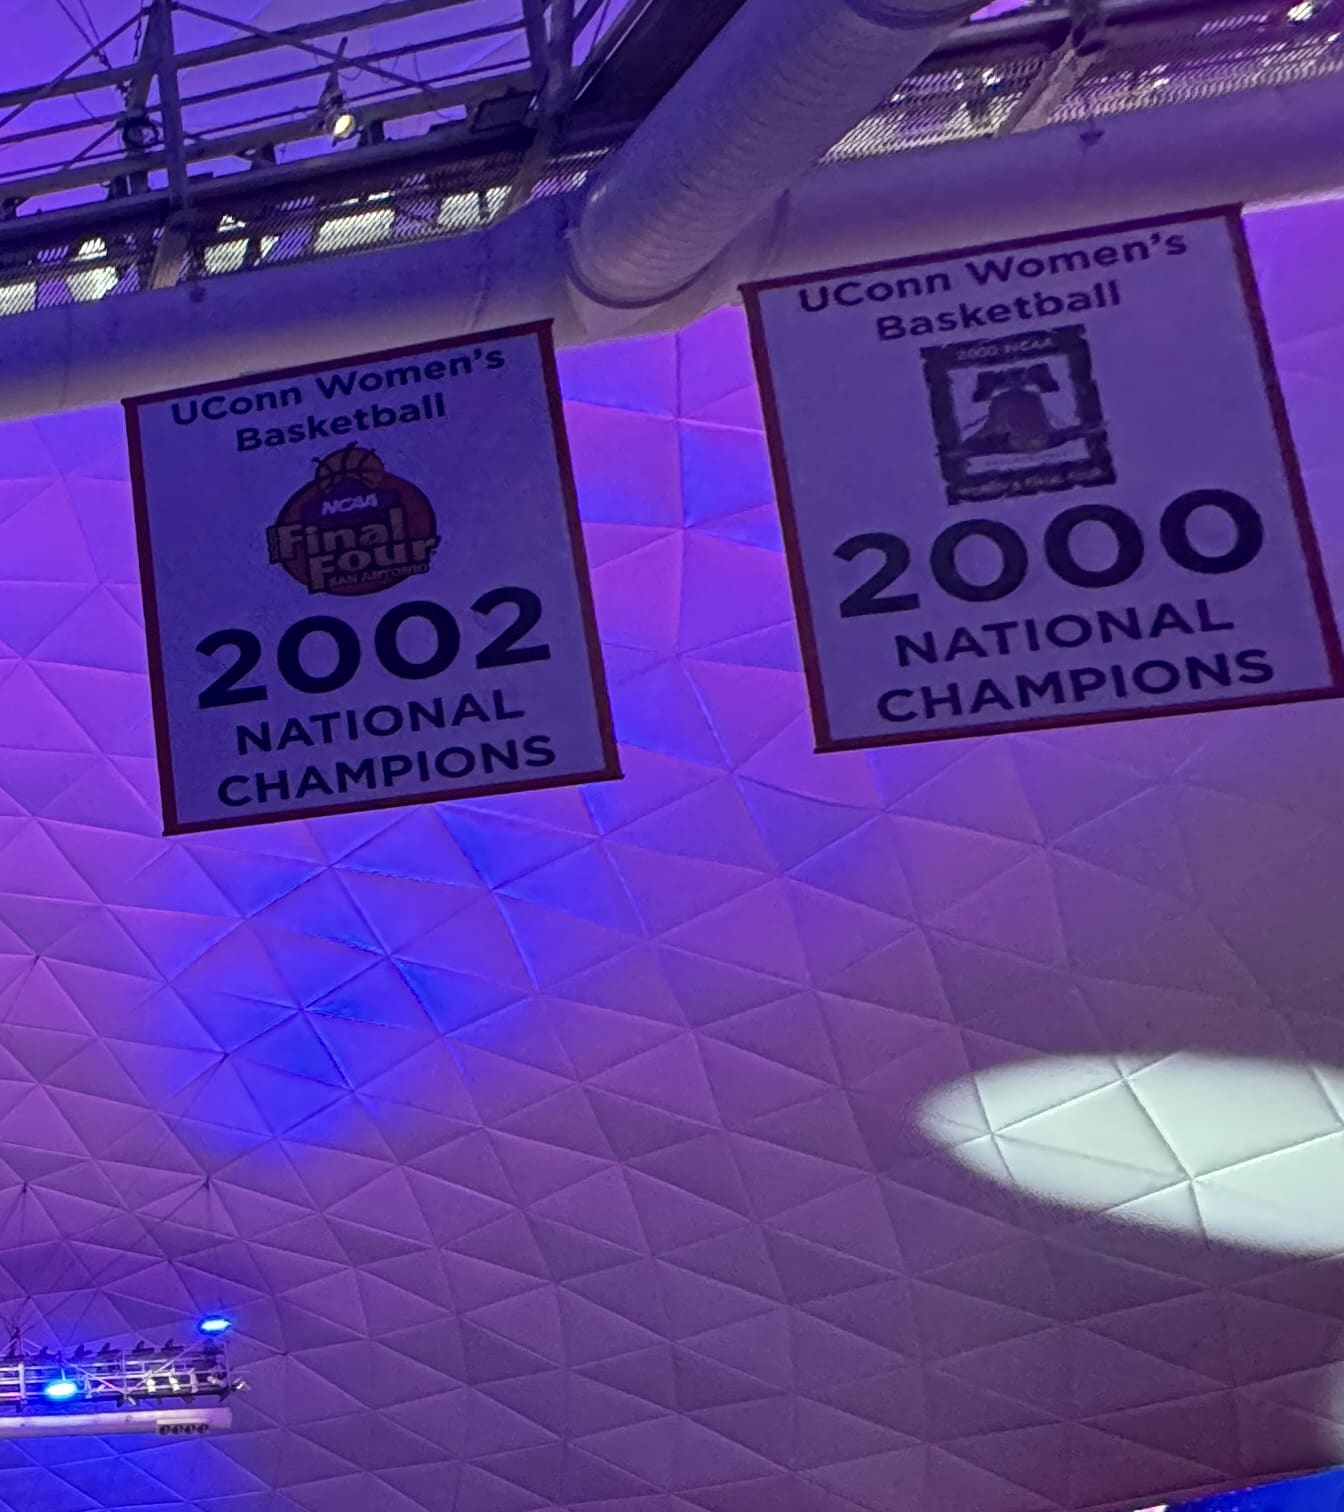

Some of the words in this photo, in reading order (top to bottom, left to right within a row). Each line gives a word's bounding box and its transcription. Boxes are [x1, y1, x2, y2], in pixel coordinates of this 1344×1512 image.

[799, 273, 953, 313] UConn
[966, 233, 1189, 287] Women's
[876, 280, 1122, 342] Basketball
[957, 343, 998, 361] 2000
[172, 387, 302, 426] UConn
[315, 348, 506, 399] Women's
[236, 393, 446, 452] Basketball
[277, 508, 406, 560] Final
[320, 493, 379, 515] NCAA
[309, 534, 437, 594] Four
[832, 488, 1265, 619] 2000
[194, 586, 551, 710] 2002
[895, 598, 1234, 667] NATIONAL
[877, 648, 1275, 723] CHAMPIONS
[236, 690, 525, 755] NATIONAL
[217, 734, 557, 807] CHAMPIONS
